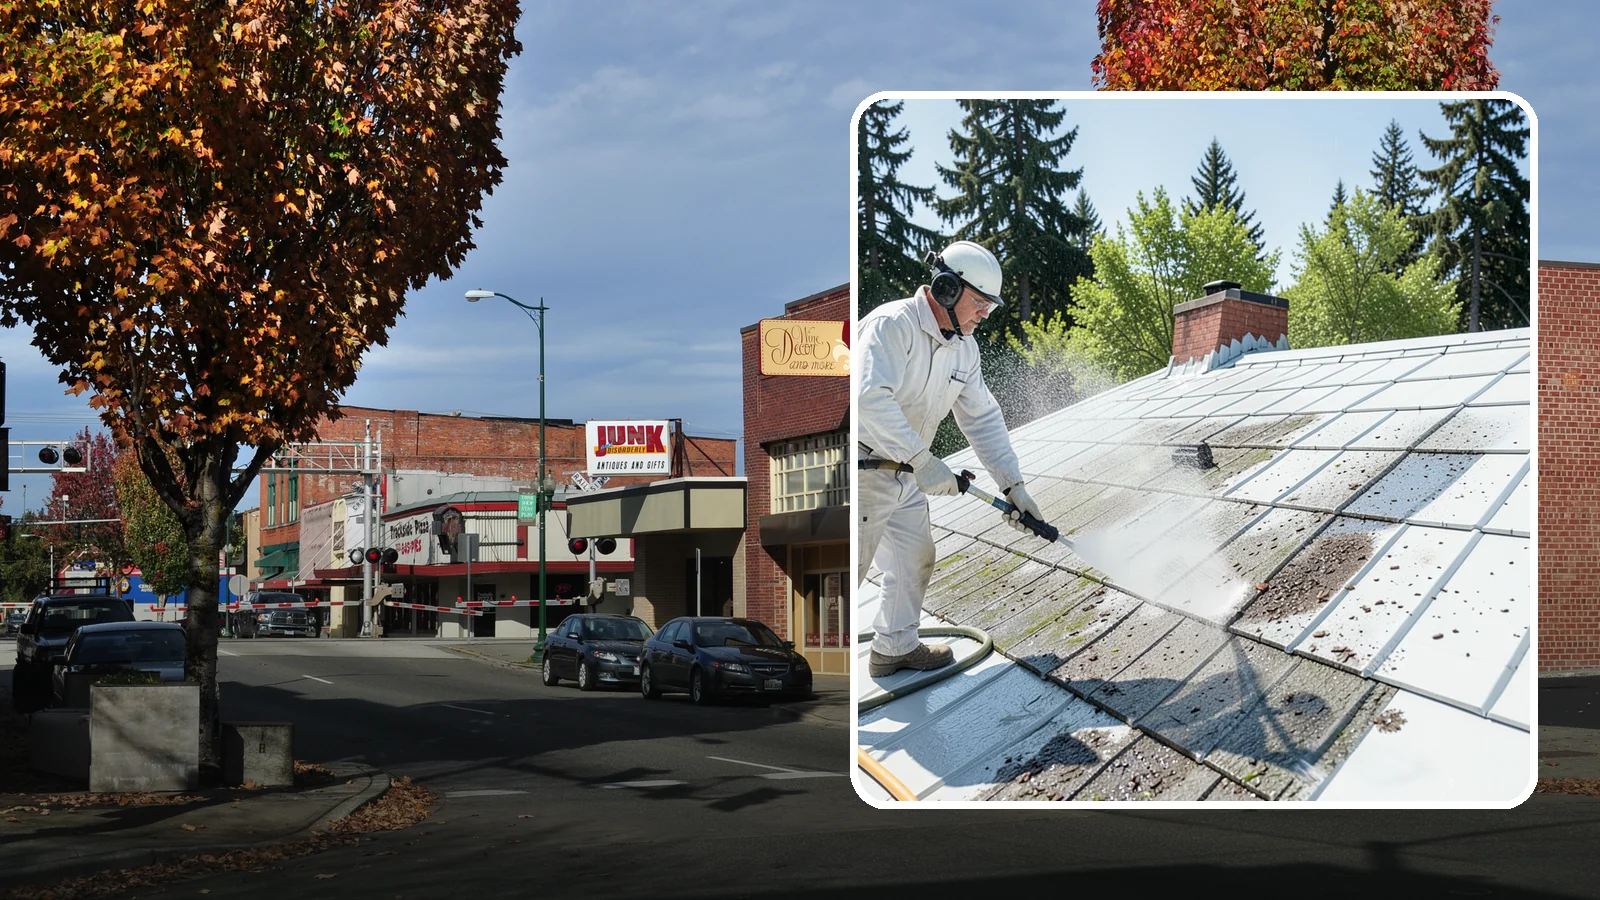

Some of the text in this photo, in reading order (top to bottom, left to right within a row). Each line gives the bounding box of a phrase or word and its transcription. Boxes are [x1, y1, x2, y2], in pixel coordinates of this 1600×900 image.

[595, 425, 665, 457] JUNK
[607, 446, 646, 454] DISORDERLY
[596, 460, 665, 470] ANTIQUES AND GIFTS
[353, 499, 365, 511] CRO
[414, 519, 429, 535] Pizza
